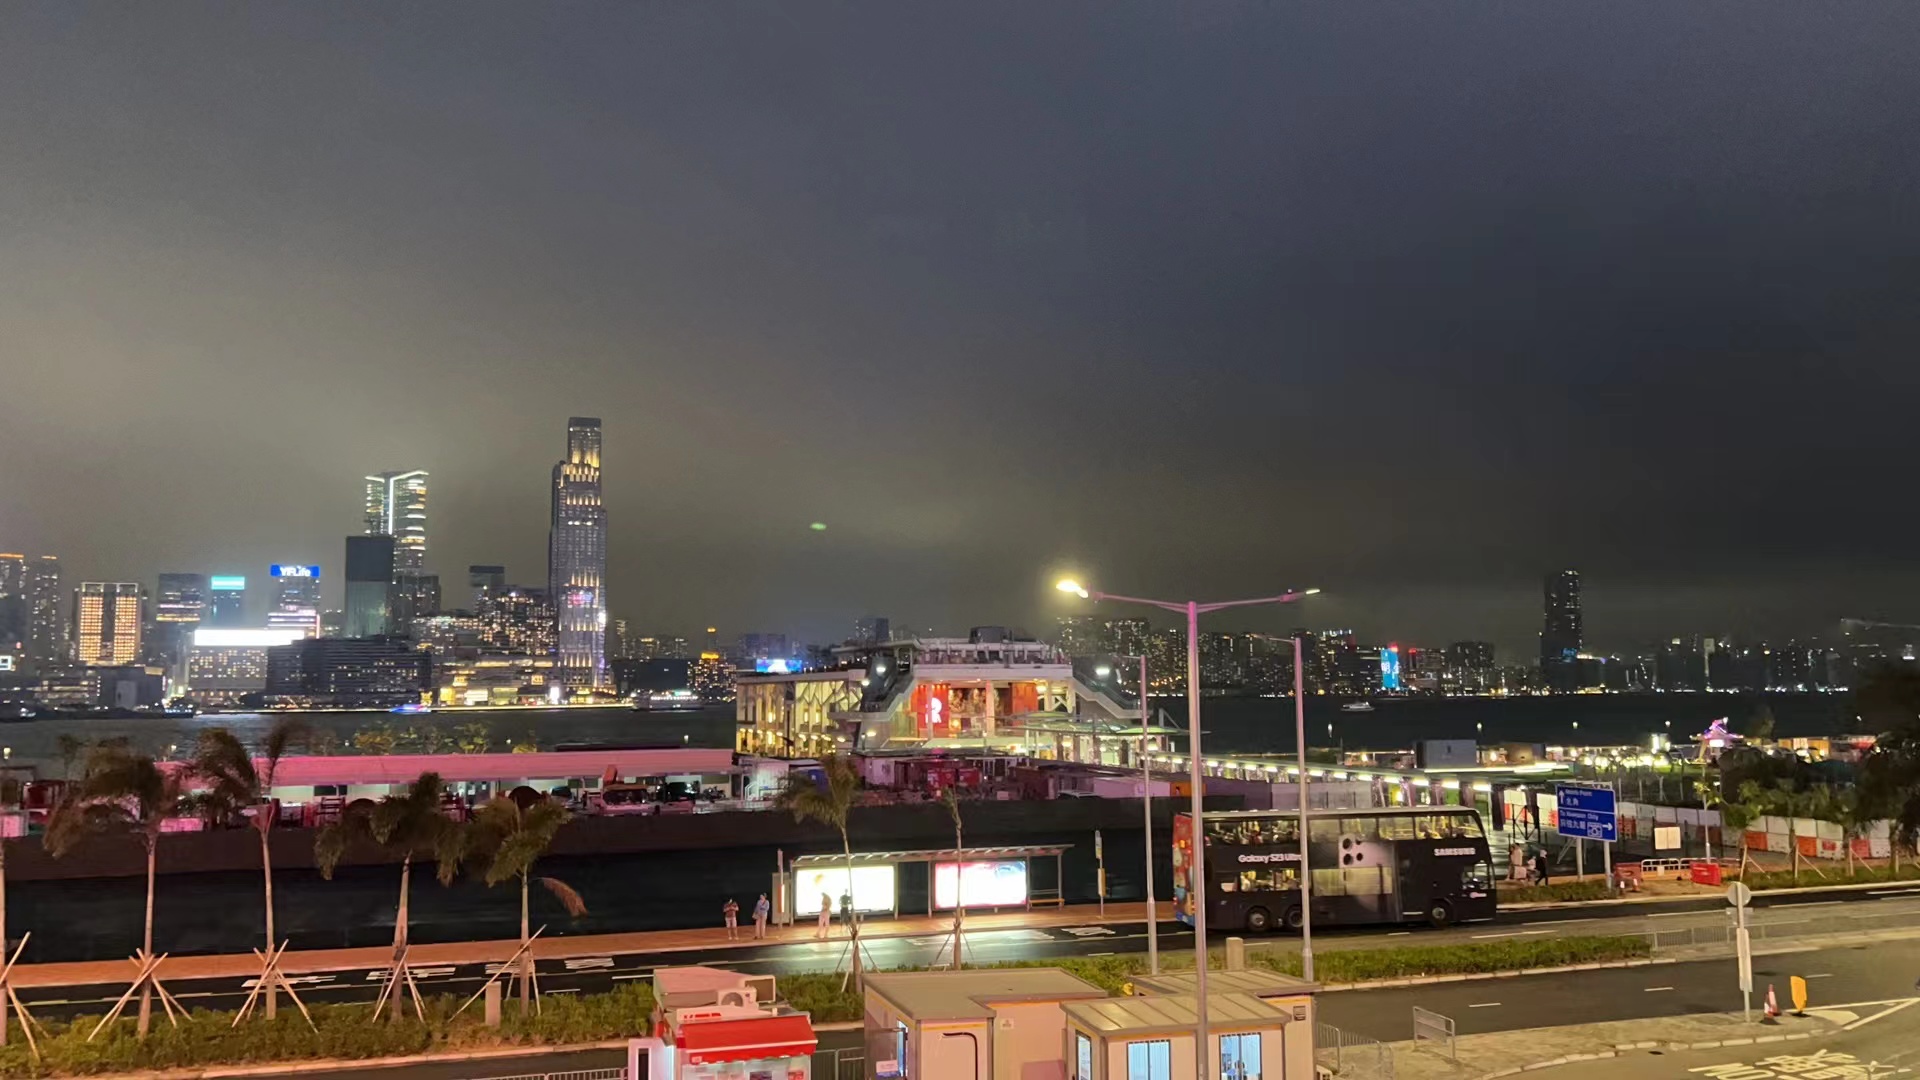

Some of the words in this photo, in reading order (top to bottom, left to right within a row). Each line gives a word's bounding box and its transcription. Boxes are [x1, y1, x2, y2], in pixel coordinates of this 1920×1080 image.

[1434, 847, 1476, 856] SAMSUNG
[1238, 854, 1269, 863] Galaxy
[1270, 853, 1284, 862] S23
